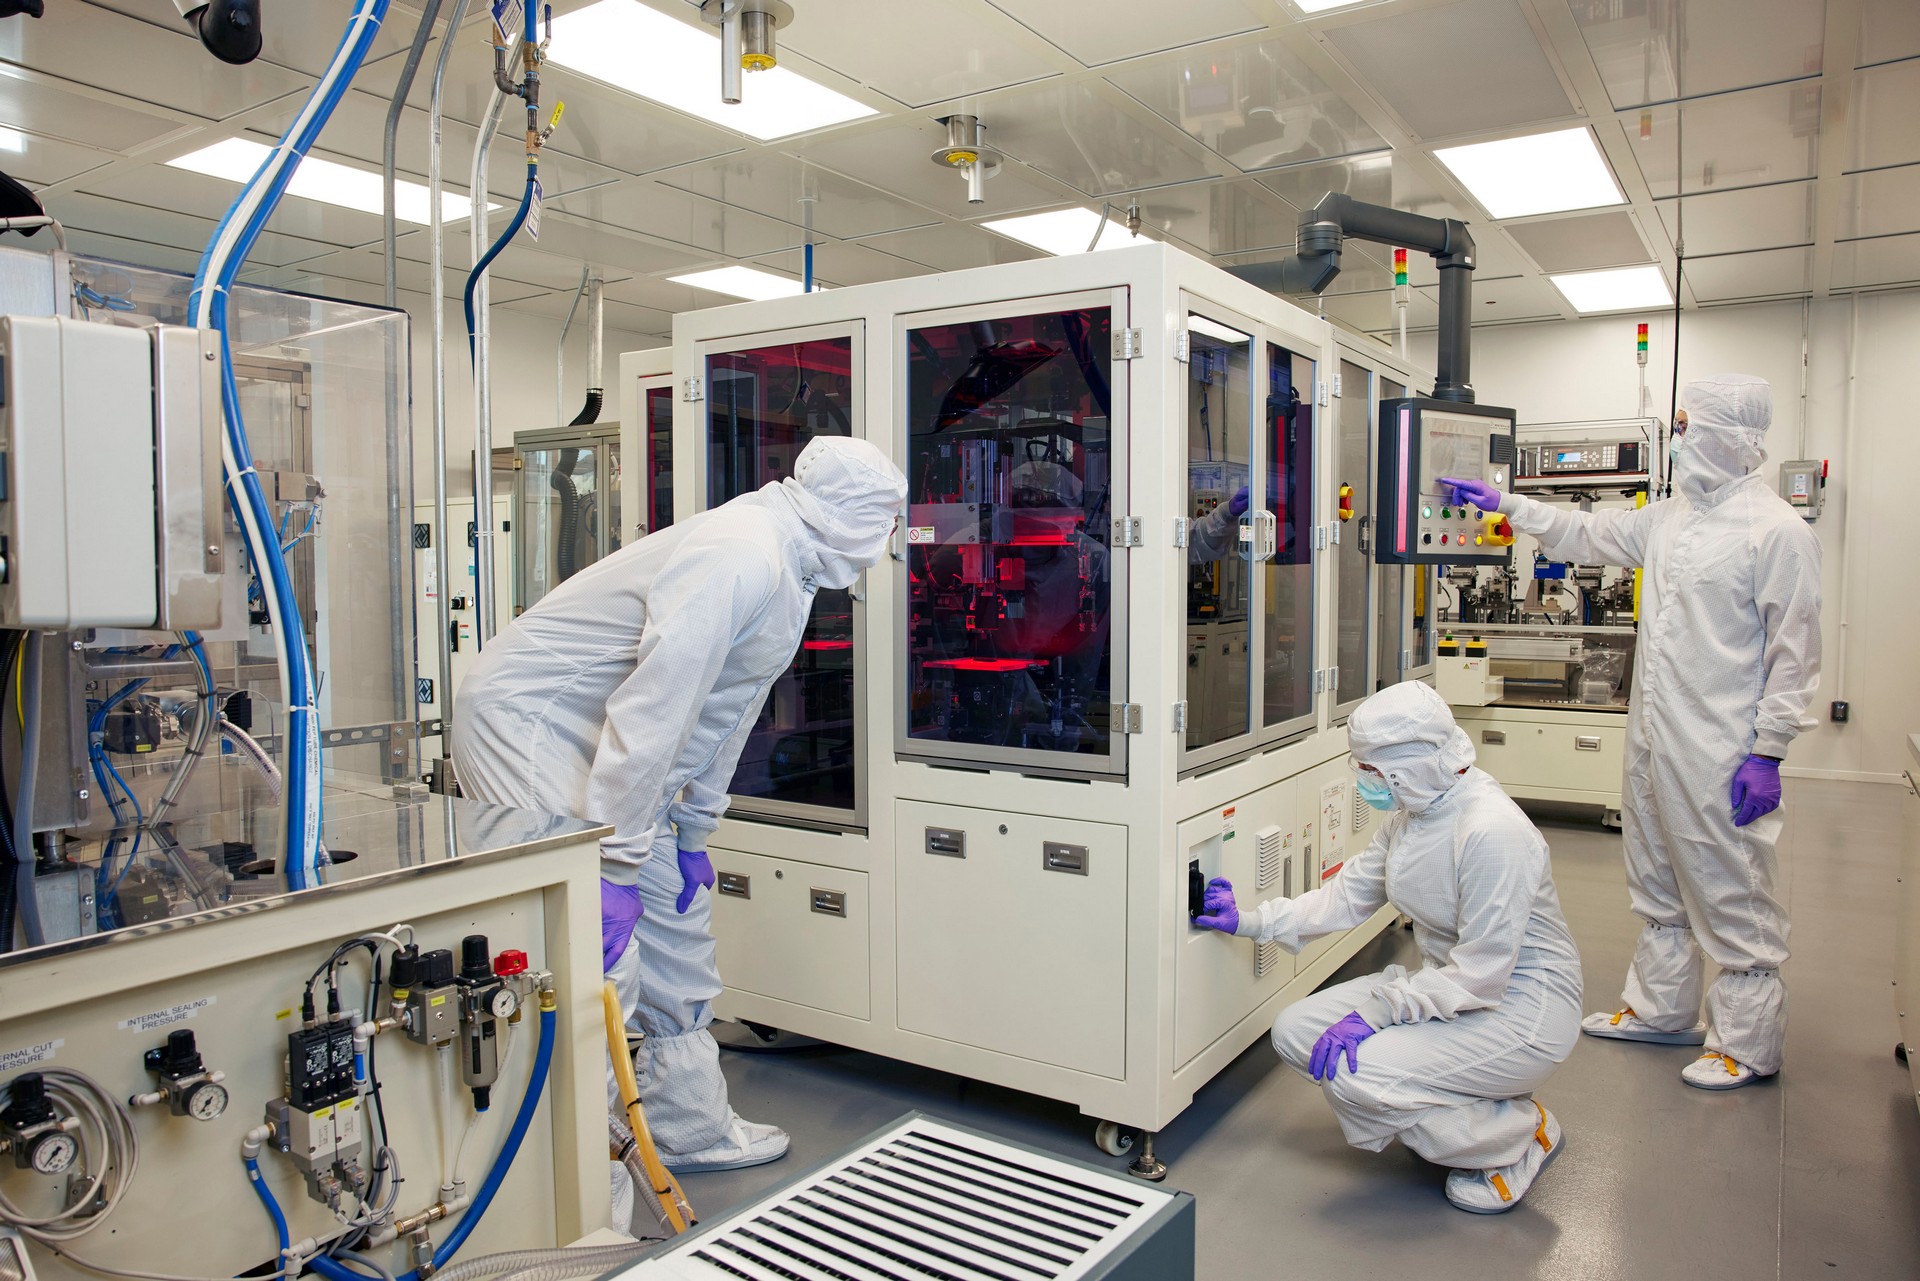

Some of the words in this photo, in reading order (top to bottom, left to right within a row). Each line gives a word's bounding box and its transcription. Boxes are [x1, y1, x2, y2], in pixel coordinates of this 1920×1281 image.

[127, 1009, 169, 1026] INTERNAL
[172, 999, 208, 1013] SEALING
[142, 1012, 188, 1030] PRESSURE
[33, 1042, 53, 1053] CUT
